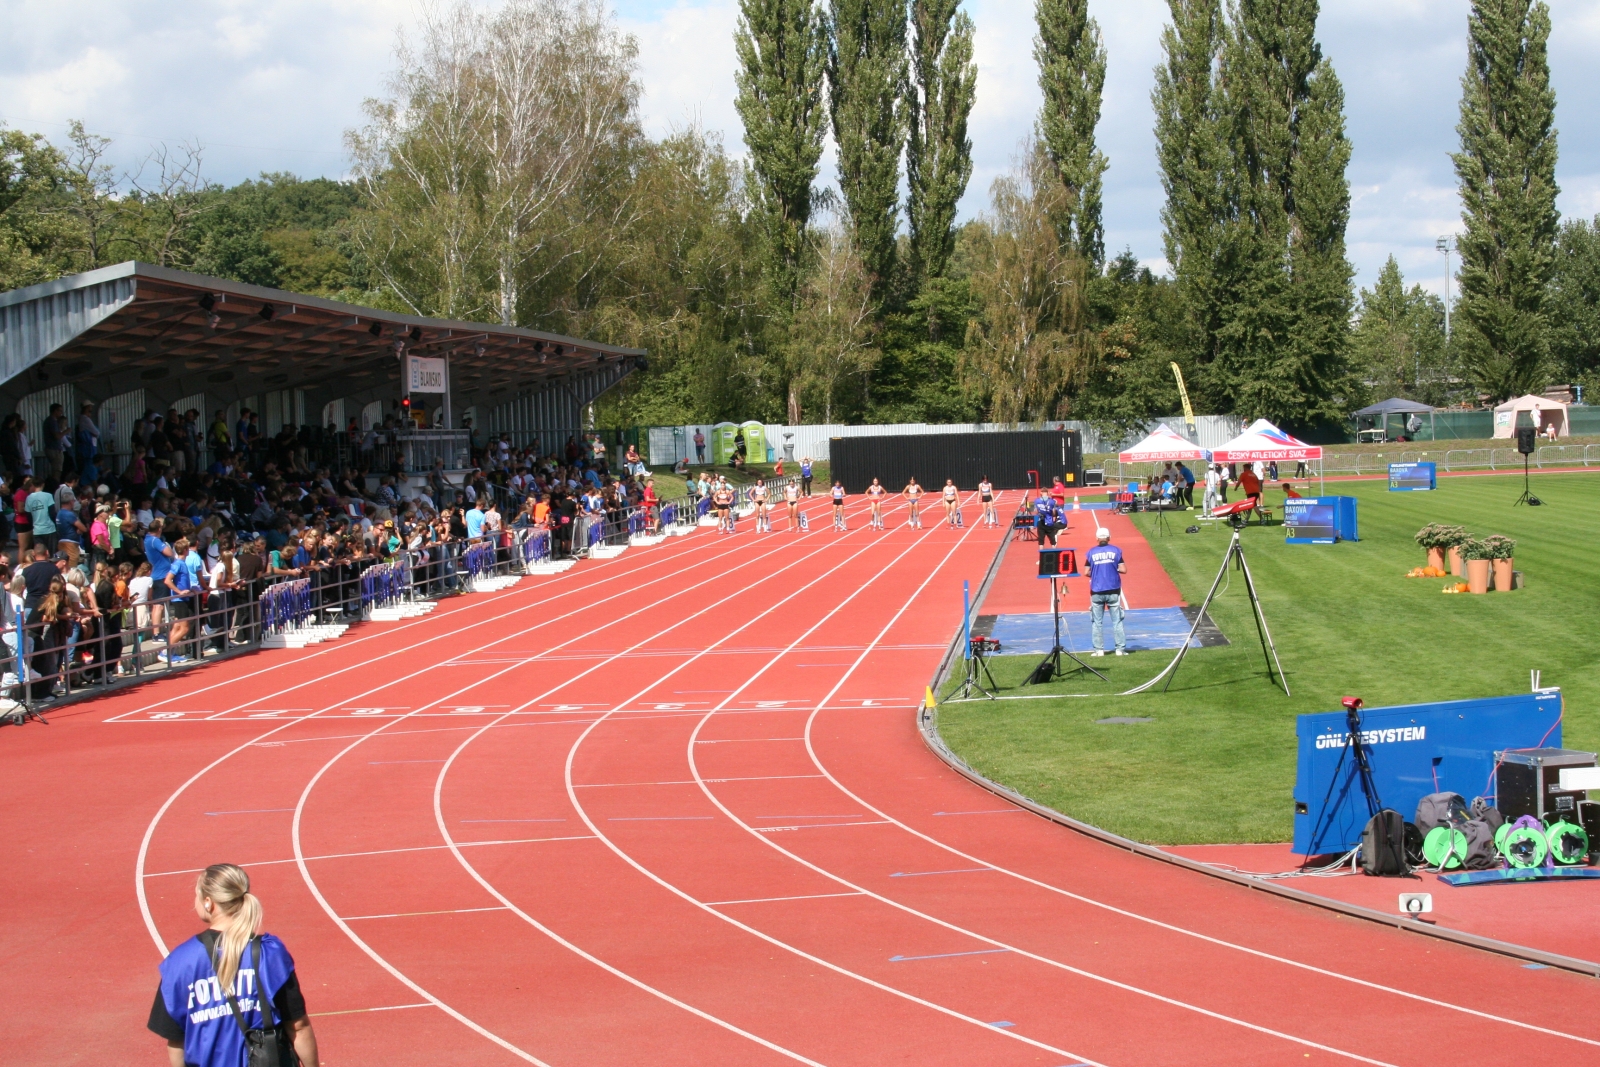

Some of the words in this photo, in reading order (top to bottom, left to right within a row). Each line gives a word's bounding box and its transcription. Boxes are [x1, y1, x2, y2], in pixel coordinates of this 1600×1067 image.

[420, 371, 441, 387] BLANSKO
[1131, 452, 1149, 460] ČESKÝ
[1150, 451, 1180, 459] ATLETICKÝ
[1227, 450, 1250, 460] ČESKÝ
[1251, 449, 1288, 459] ATLETICKÝ
[1289, 449, 1307, 458] SVAZ
[1286, 528, 1295, 538] A3
[1058, 550, 1074, 574] 0
[1315, 726, 1426, 750] ONLESYSTEM
[187, 968, 256, 1010] FOT/T
